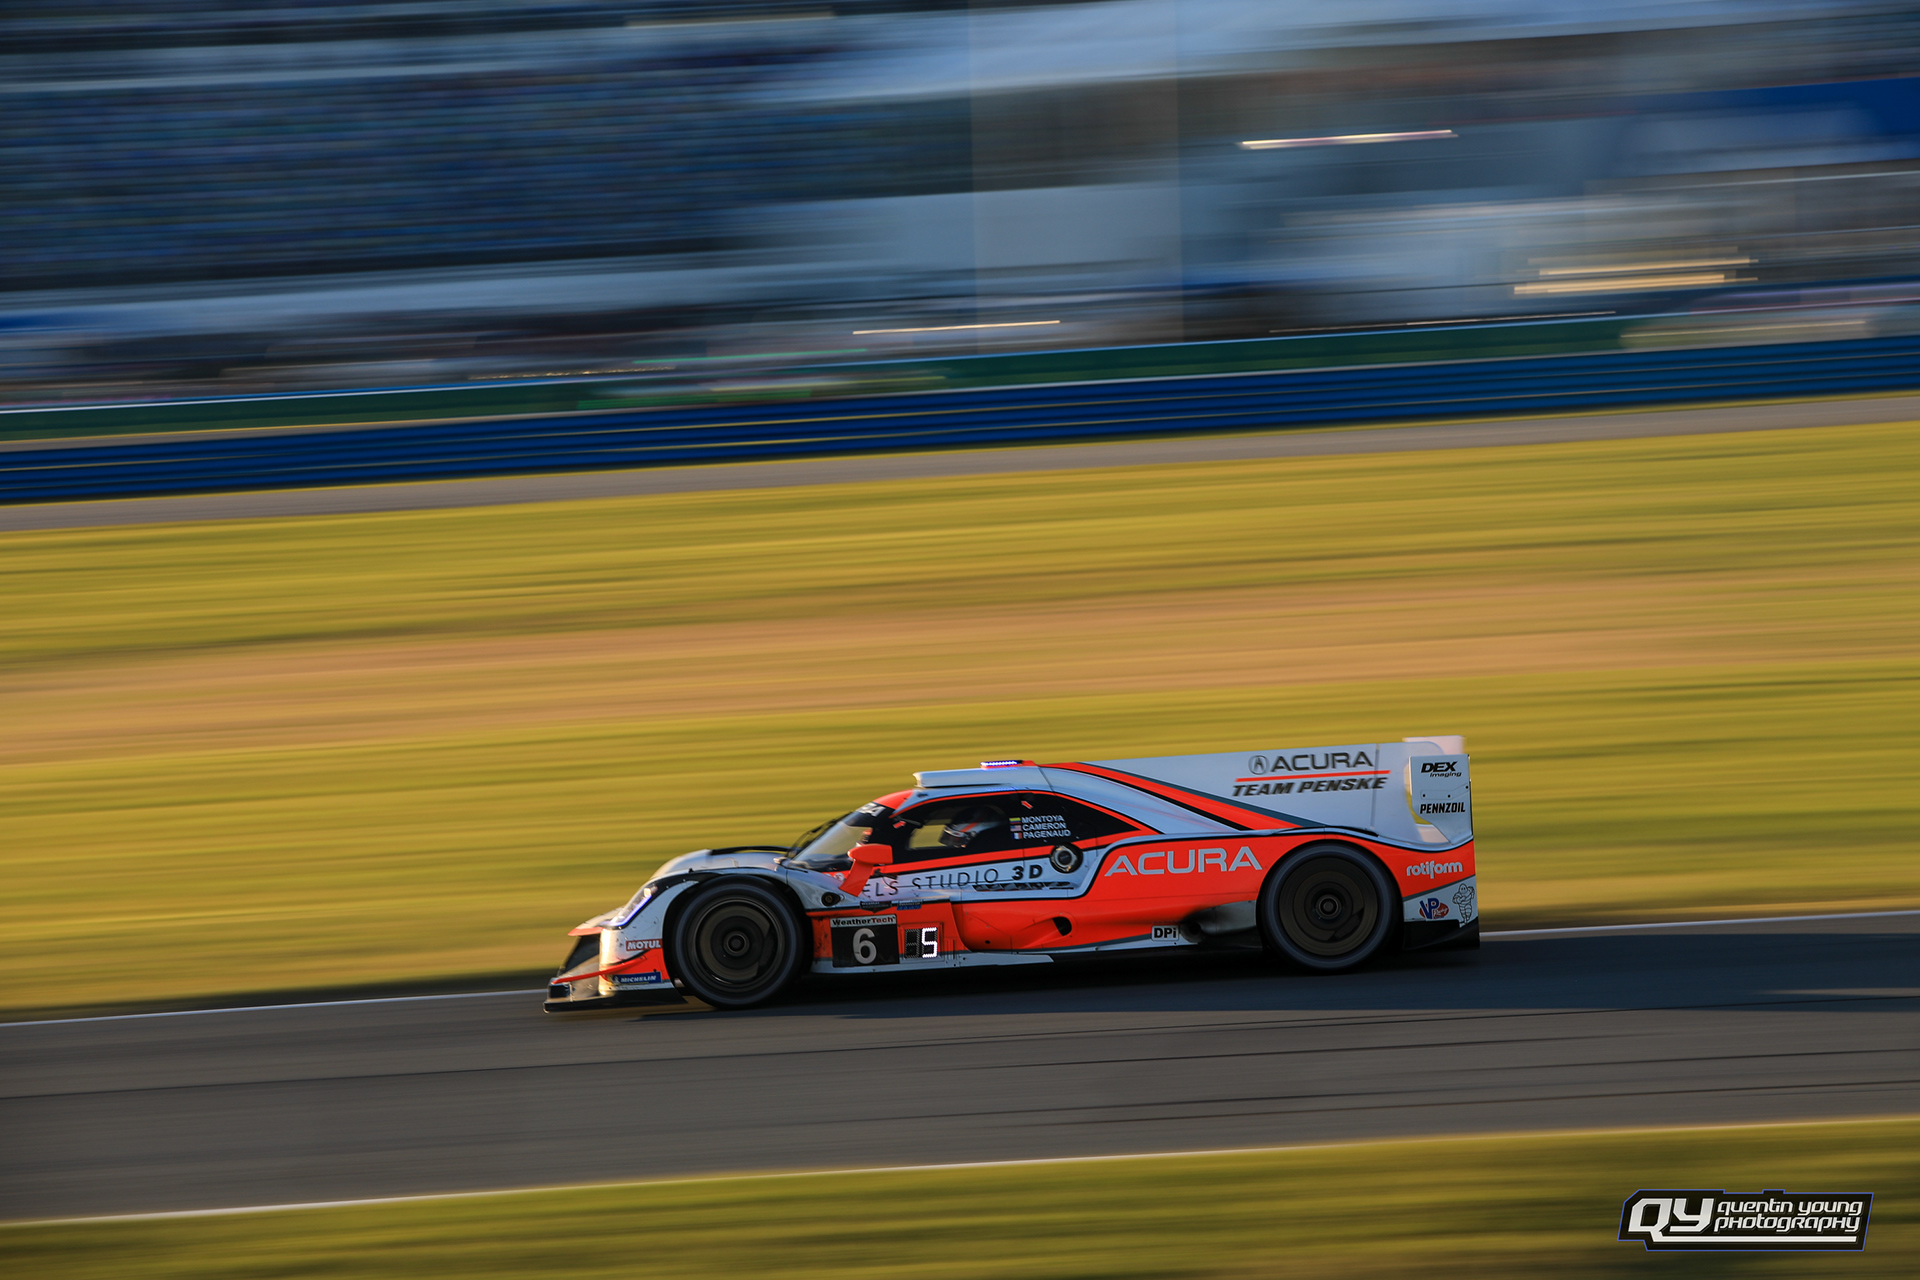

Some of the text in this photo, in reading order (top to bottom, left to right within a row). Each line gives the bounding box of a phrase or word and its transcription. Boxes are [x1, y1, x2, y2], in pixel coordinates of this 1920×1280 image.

[1270, 751, 1374, 773] ACURA
[1421, 761, 1458, 773] DEX
[1232, 777, 1388, 796] TEAM PENSKE
[1420, 802, 1466, 814] PENNZOIL
[1021, 815, 1064, 824] MONTOYA
[1022, 822, 1067, 831] CAMERON
[1023, 829, 1071, 839] PAGENAUD
[1104, 846, 1263, 877] ACURA
[1012, 864, 1043, 881] 3D
[1406, 860, 1463, 879] rotiform
[832, 916, 895, 926] WeatherTech
[1153, 927, 1177, 939] DPi
[627, 940, 661, 950] MOTUL
[852, 928, 877, 964] 6
[921, 927, 938, 958] 5
[620, 975, 657, 983] MICHELIN
